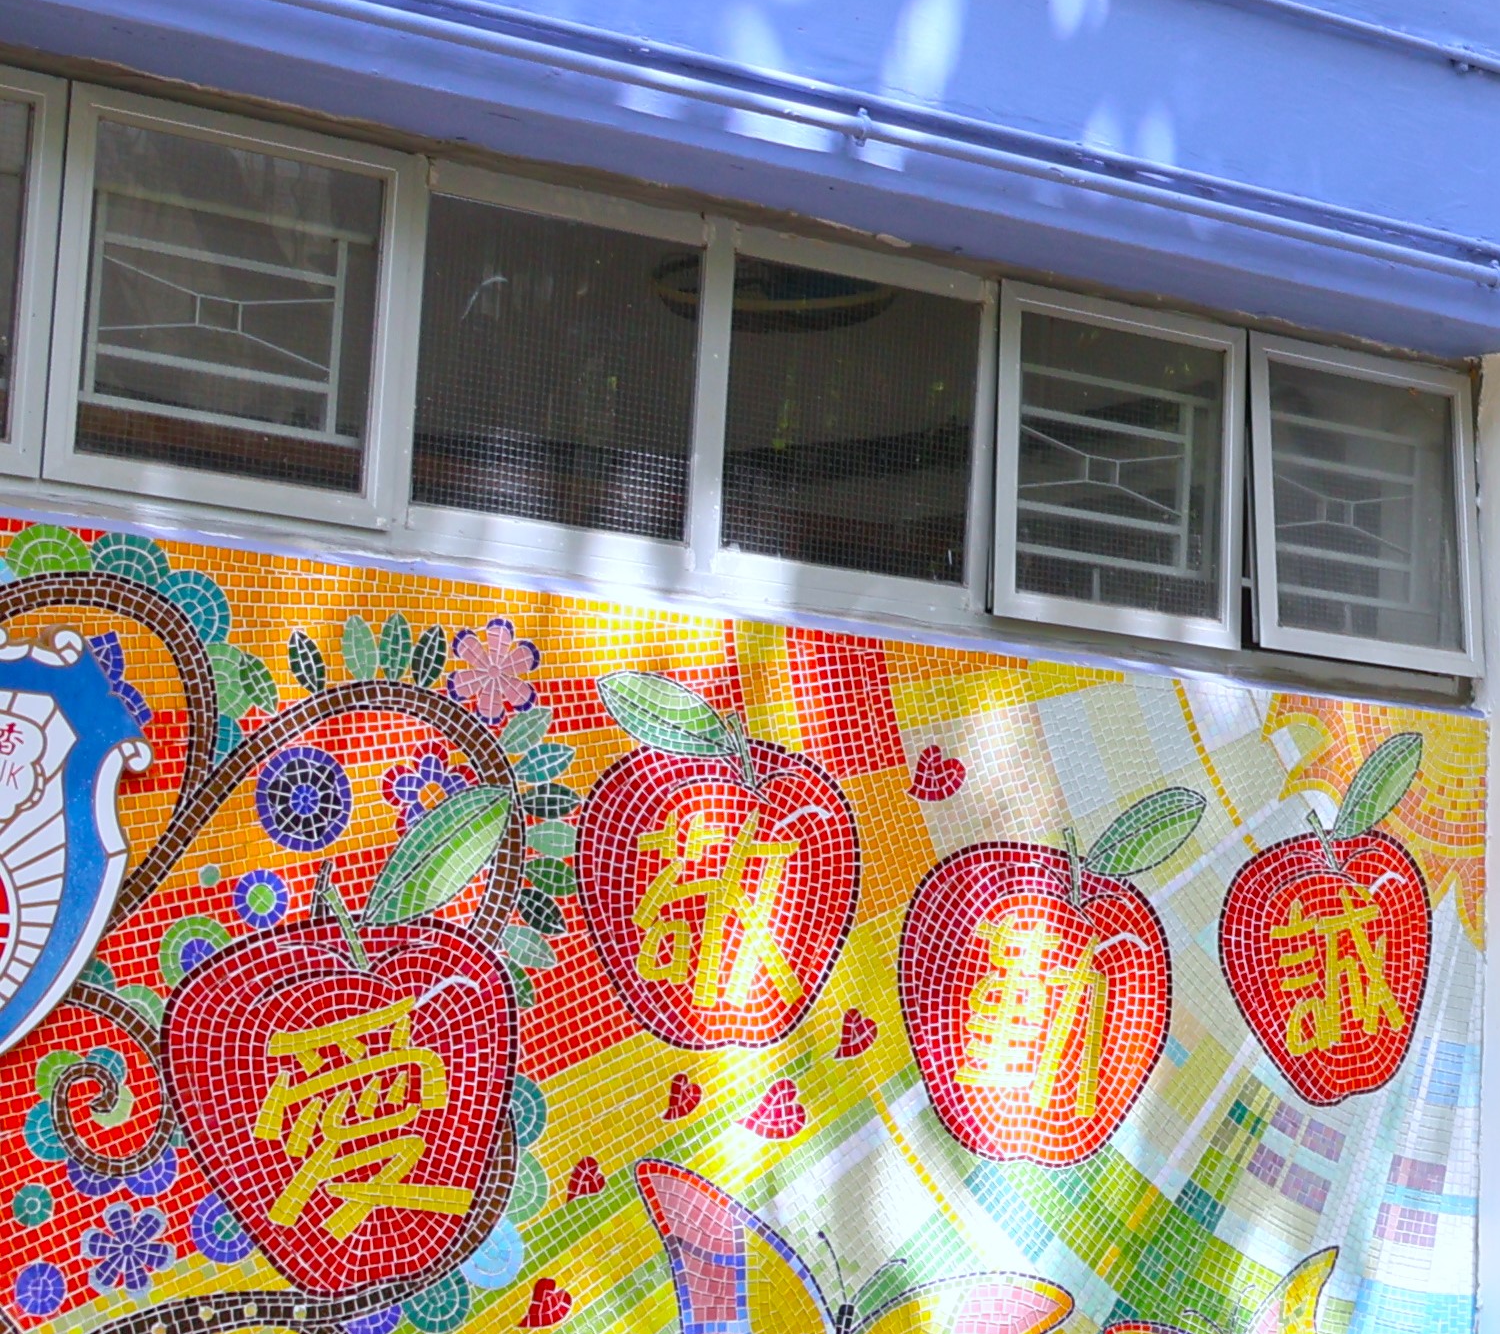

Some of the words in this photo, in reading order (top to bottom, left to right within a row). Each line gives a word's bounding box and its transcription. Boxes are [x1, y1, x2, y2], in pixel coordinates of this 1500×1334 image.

[257, 998, 474, 1240] 愛
[632, 808, 804, 1009] 敬
[953, 915, 1108, 1119] 勤
[1270, 884, 1406, 1057] 誠
